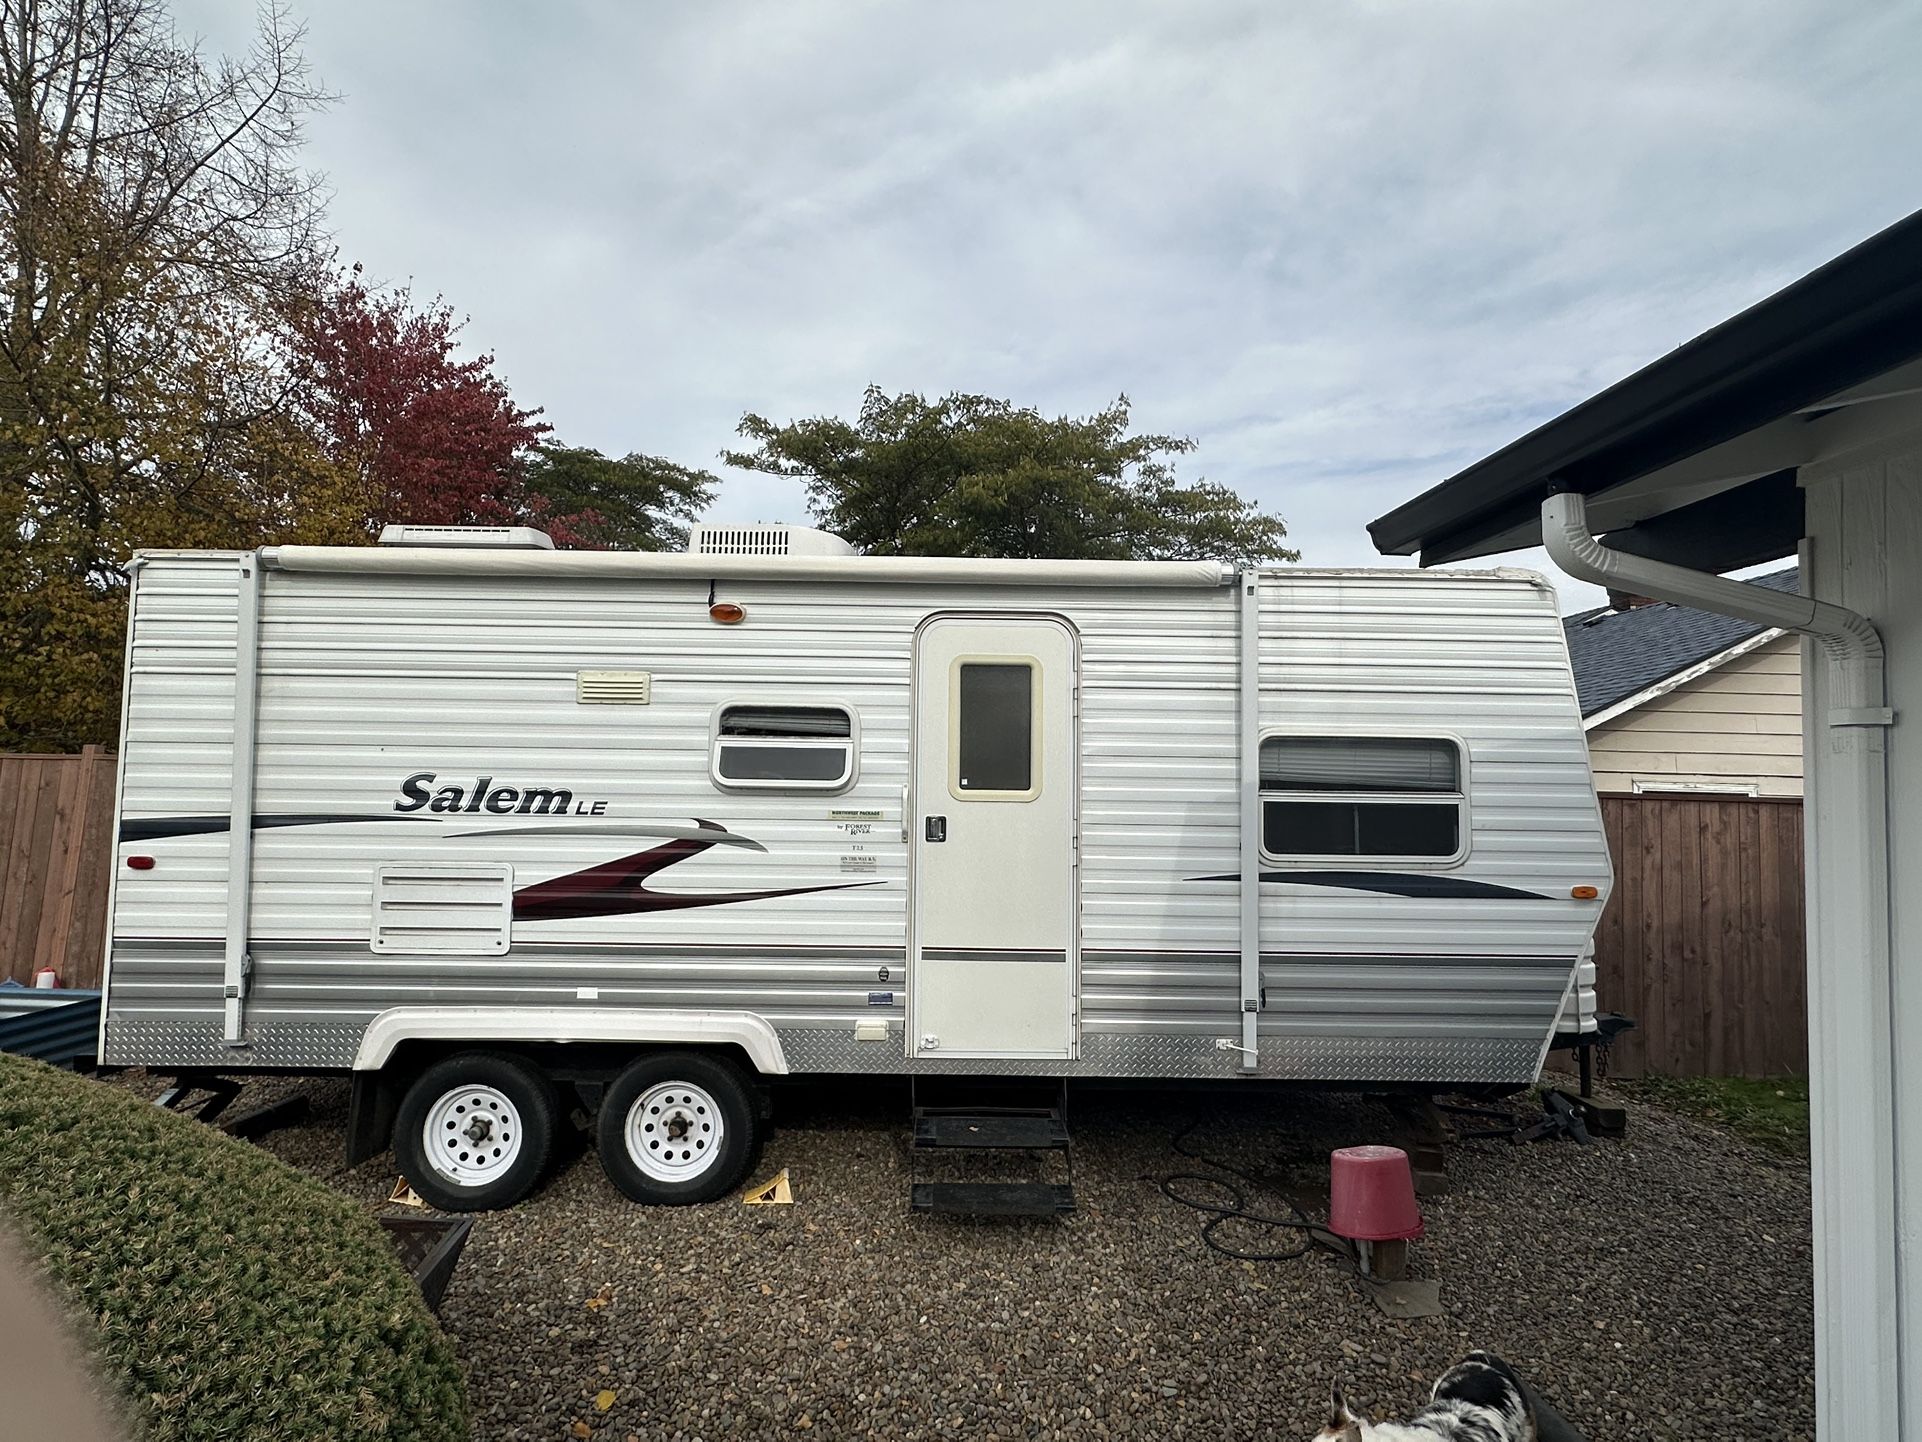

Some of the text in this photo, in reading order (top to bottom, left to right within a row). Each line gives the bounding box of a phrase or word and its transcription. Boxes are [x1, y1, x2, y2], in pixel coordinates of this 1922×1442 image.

[393, 771, 608, 816] Salem LE
[845, 823, 872, 831] FOREST
